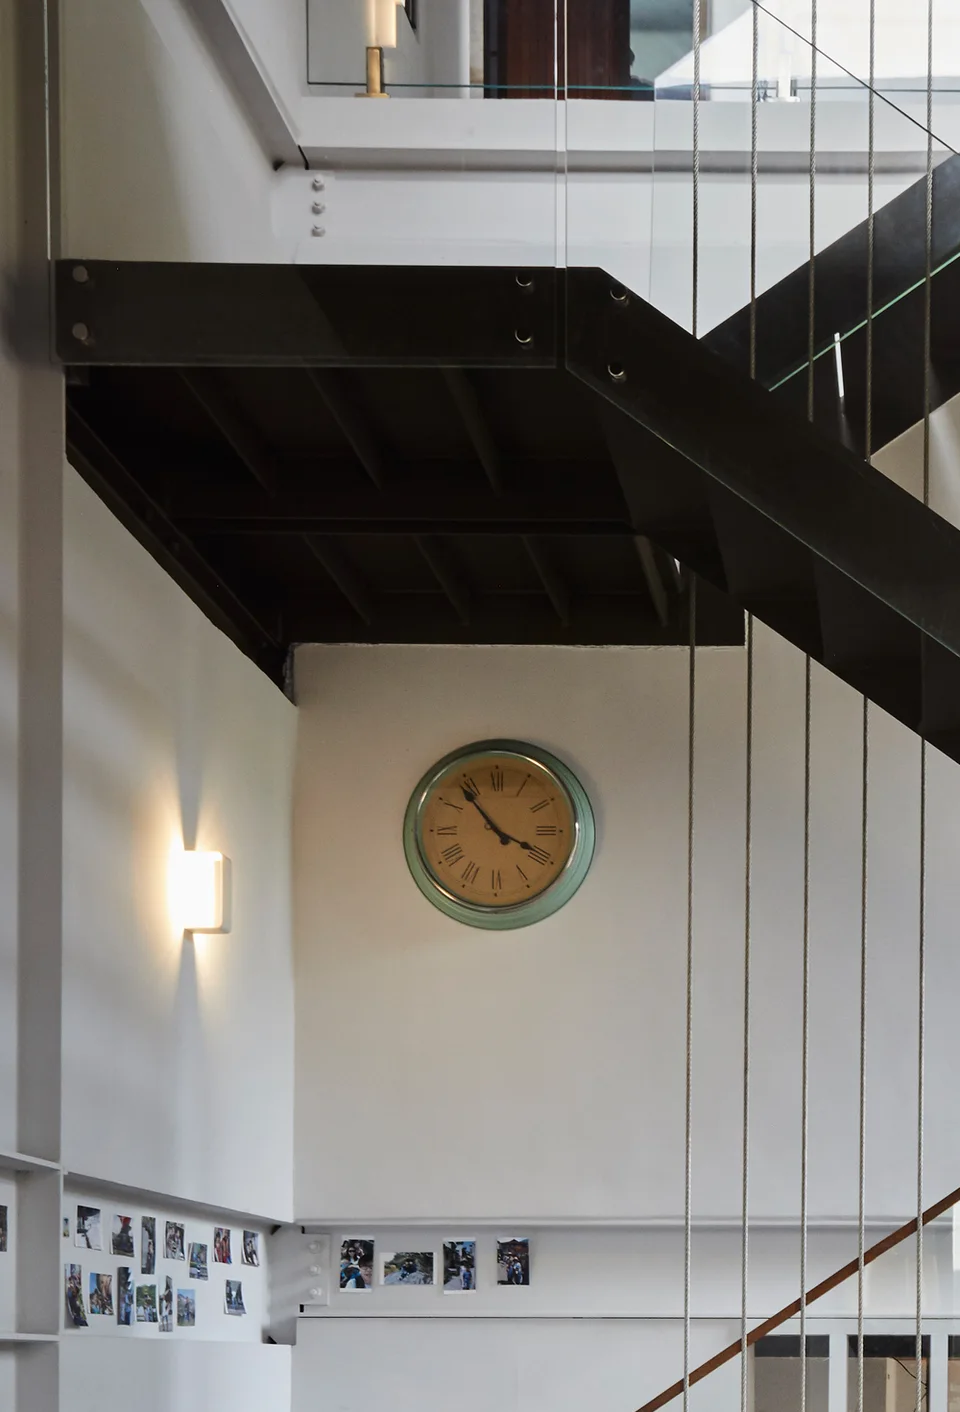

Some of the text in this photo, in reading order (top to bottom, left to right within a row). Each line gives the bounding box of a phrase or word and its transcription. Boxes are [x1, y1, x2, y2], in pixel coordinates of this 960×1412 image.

[490, 771, 504, 791] XII
[516, 778, 528, 797] I
[530, 799, 550, 813] II
[437, 825, 457, 835] IX
[536, 825, 556, 836] III
[491, 869, 502, 890] VI
